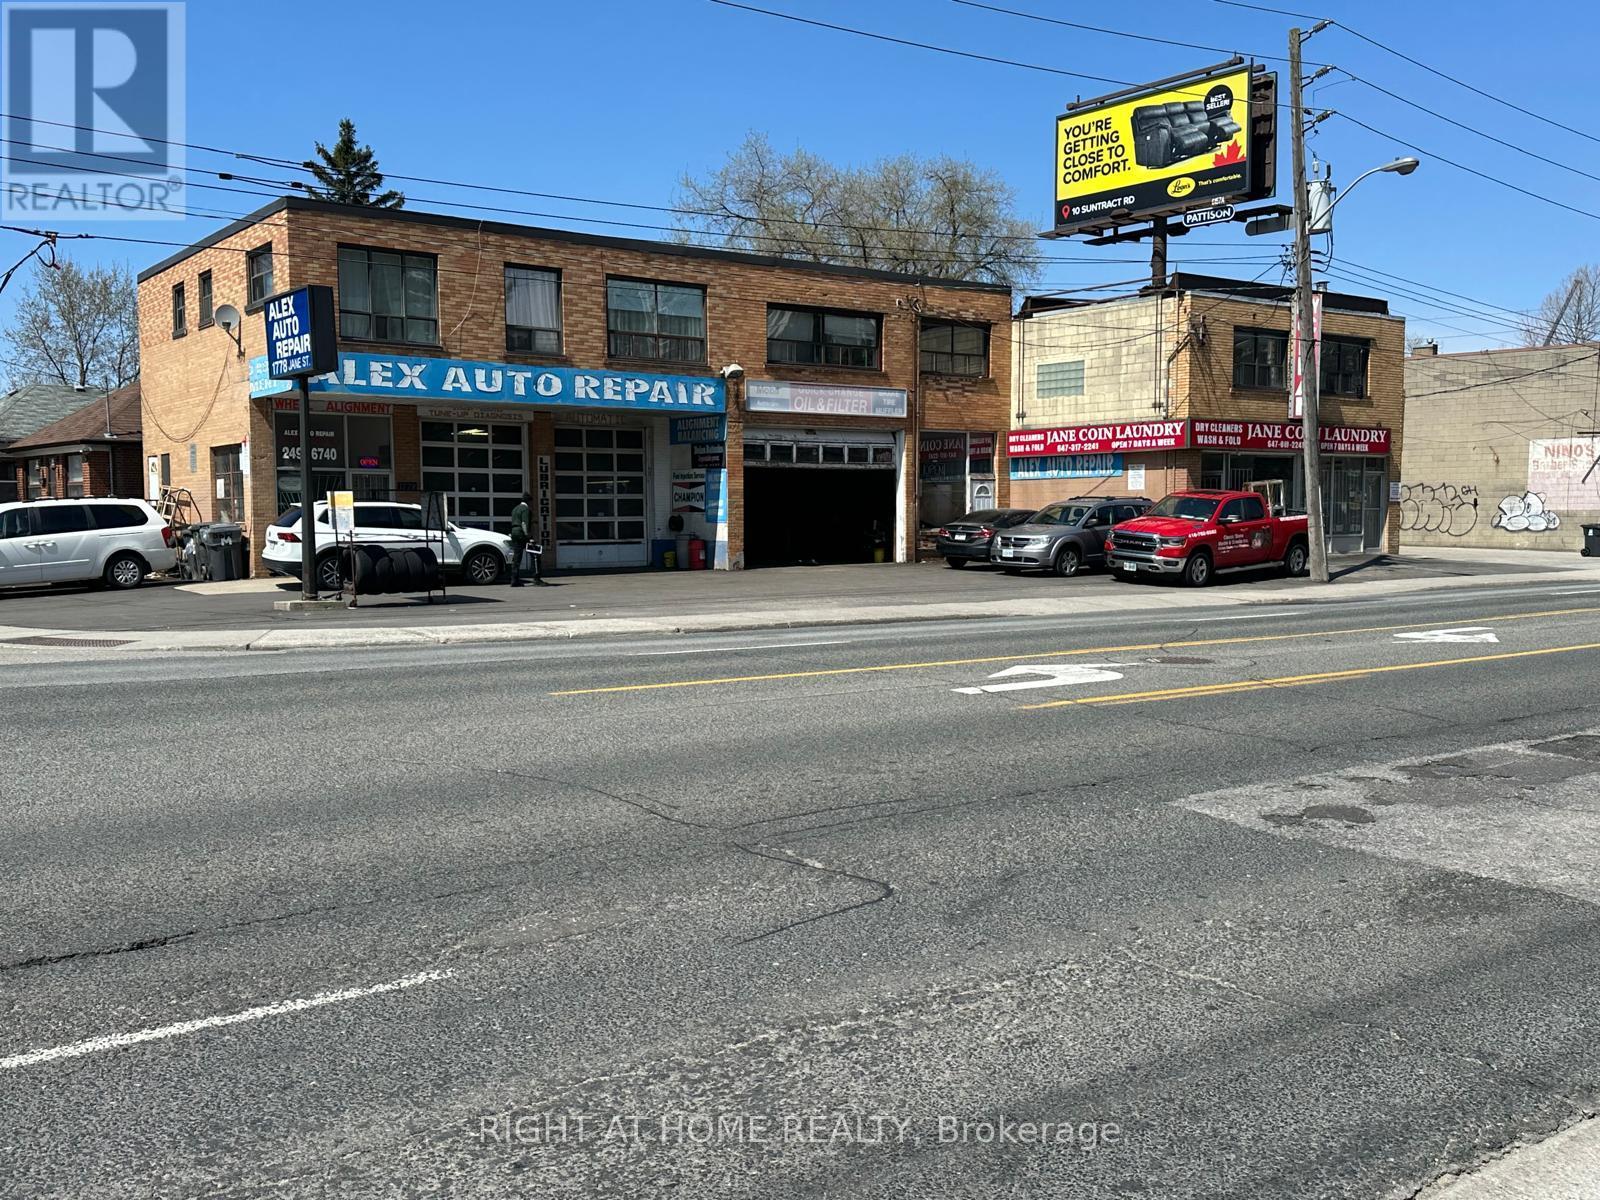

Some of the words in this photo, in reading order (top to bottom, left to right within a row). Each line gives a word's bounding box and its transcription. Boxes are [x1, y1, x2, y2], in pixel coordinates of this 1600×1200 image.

[1210, 93, 1226, 103] BEST
[1064, 117, 1112, 140] YOU'RE
[1064, 131, 1120, 155] GETTING
[1063, 149, 1104, 169] CLOSE
[1109, 144, 1125, 159] TO
[1063, 159, 1131, 184] COMFORT.
[1198, 179, 1212, 187] That's
[1071, 207, 1080, 215] 10
[1081, 199, 1122, 214] SUNTRACT
[1123, 196, 1135, 205] RD
[1186, 208, 1231, 223] PATTISON
[268, 295, 295, 321] ALEX
[273, 316, 299, 340] AUTO
[276, 334, 311, 359] REPAIR
[271, 361, 288, 376] 1778
[288, 358, 301, 371] JANE
[302, 355, 311, 367] ST.
[441, 366, 563, 396] AUTO
[574, 374, 716, 405] REPAIR
[325, 401, 391, 414] ALIGNMENT
[429, 409, 469, 417] TUNE-UP
[473, 411, 524, 420] DIAGNOSIS
[677, 416, 720, 429] ALIGNMENT
[1195, 422, 1209, 432] DRY
[1210, 423, 1243, 433] CLEANERS
[677, 428, 720, 440] BALANCING
[1009, 435, 1019, 443] DRY
[1046, 429, 1077, 445] JANE
[1078, 426, 1113, 442] COIN
[1115, 421, 1184, 440] LAUNDRY
[1197, 435, 1217, 445] WASH
[1218, 435, 1224, 445] &
[1225, 436, 1241, 445] FOLD
[1247, 424, 1281, 440] JANE
[1325, 427, 1387, 443] LAUNDRY
[1010, 444, 1024, 453] WASH
[1031, 443, 1044, 452] FOLD
[1111, 441, 1128, 449] OPEN
[1128, 440, 1133, 448] 7
[1133, 439, 1150, 448] DAYS
[1157, 438, 1175, 446] WEEK
[1321, 442, 1334, 450] OPEN
[1337, 443, 1351, 451] DAYS
[1356, 443, 1368, 452] WEEK
[1544, 443, 1595, 458] NINO'S
[1017, 458, 1041, 477] ALEX
[1046, 456, 1073, 476] AUTO
[1076, 454, 1114, 474] REPAIR
[539, 457, 550, 546] LUBRICATION
[673, 492, 704, 502] CHAMPION
